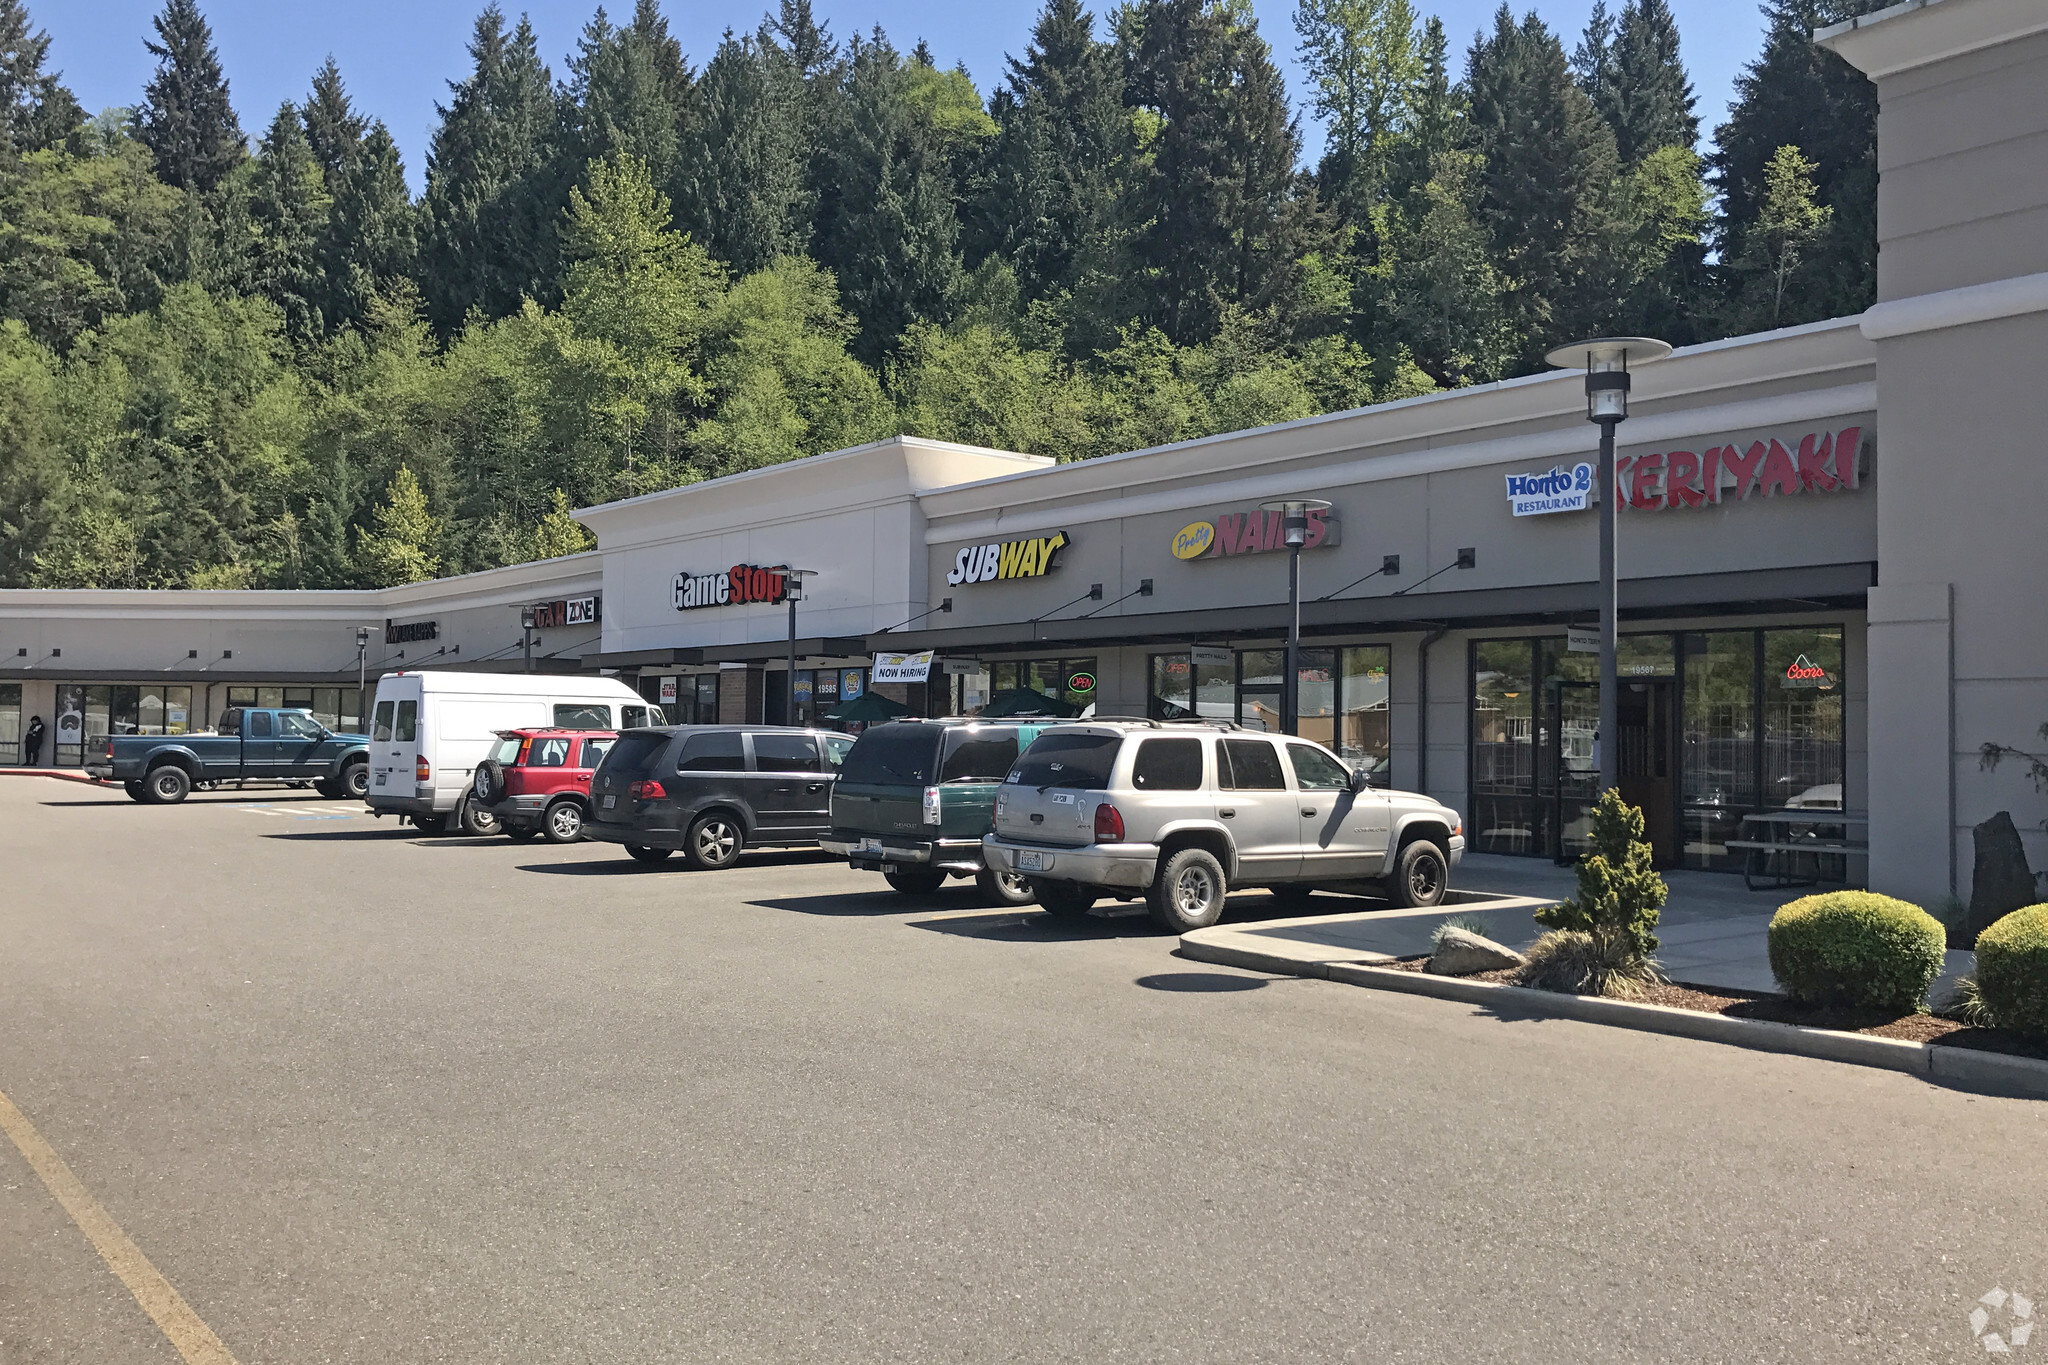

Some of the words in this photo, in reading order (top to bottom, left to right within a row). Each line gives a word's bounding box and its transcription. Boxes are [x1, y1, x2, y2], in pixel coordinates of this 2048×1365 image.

[1507, 468, 1572, 497] Honto
[1575, 465, 1590, 491] 2
[1517, 495, 1583, 513] RESTAURANT
[1177, 525, 1211, 557] Pretty
[946, 531, 1066, 586] SUBWAY
[670, 564, 784, 609] GameStop
[569, 599, 594, 622] ZONE
[878, 667, 898, 678] NOW
[899, 666, 927, 678] HIRING
[1787, 663, 1825, 679] Coors
[818, 684, 837, 693] 19585
[1072, 676, 1093, 688] OPEN
